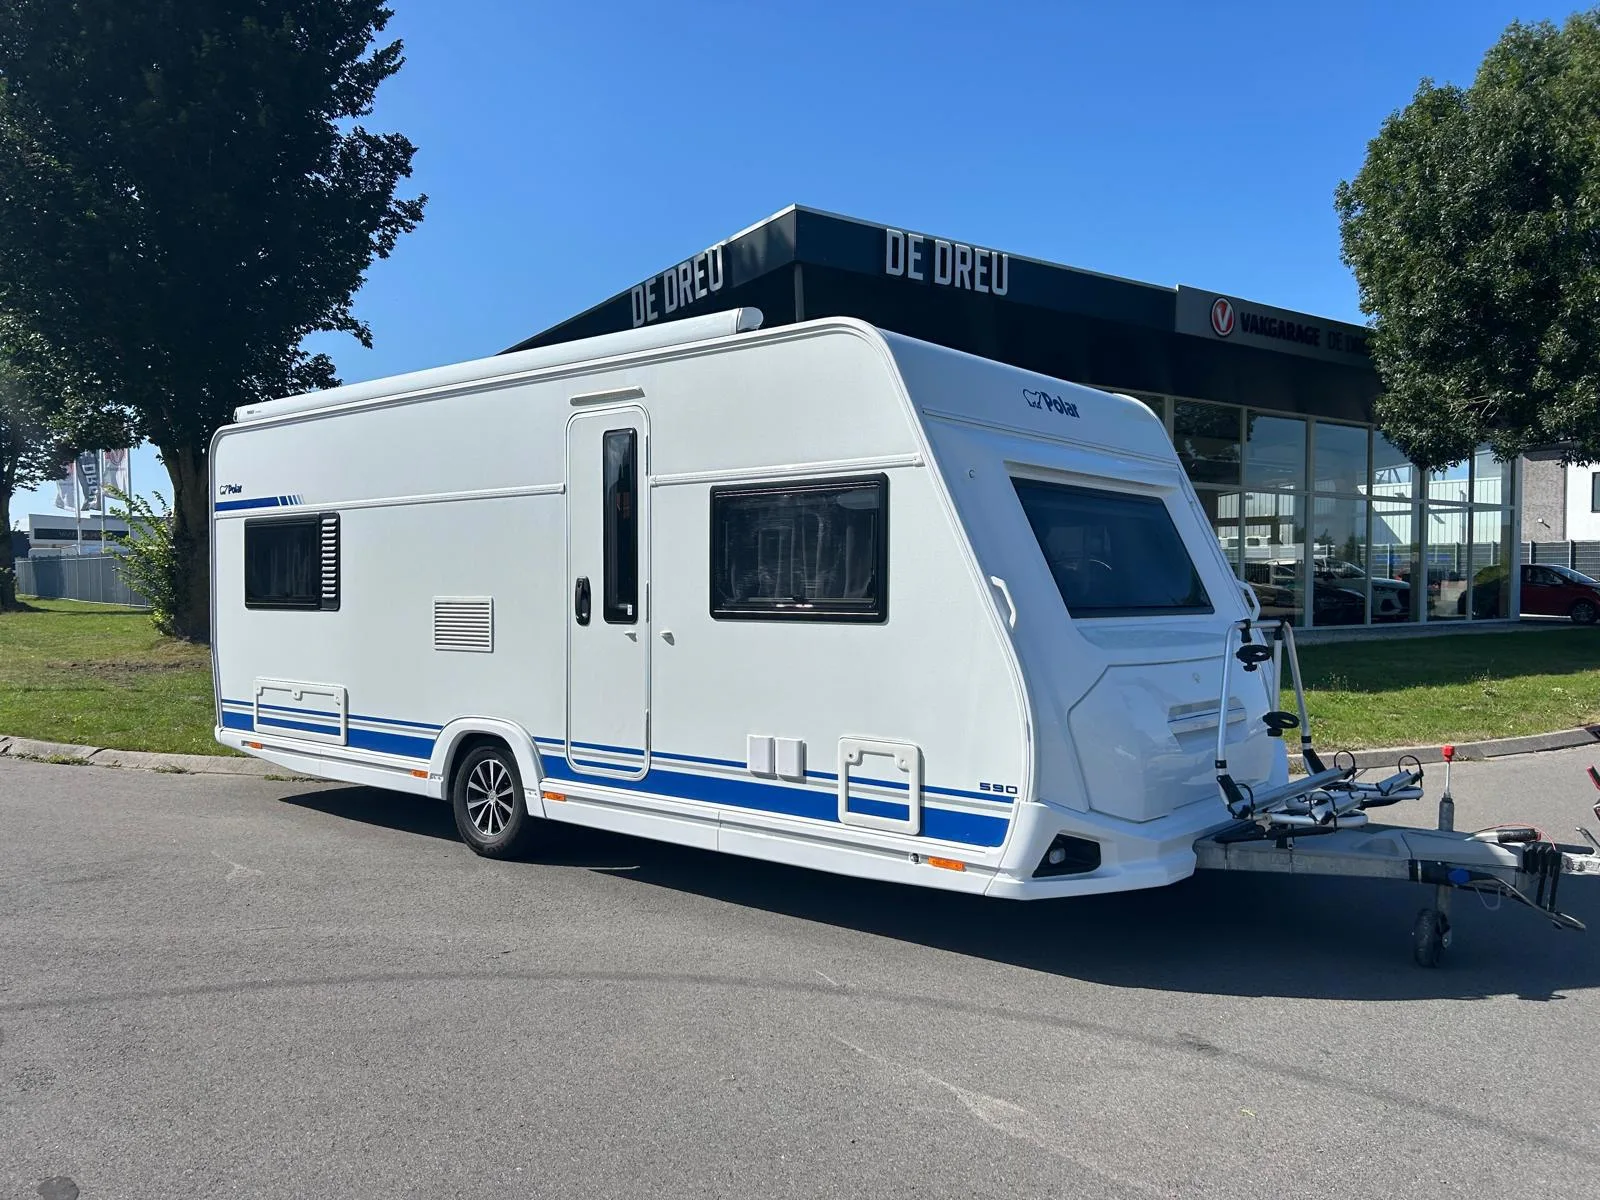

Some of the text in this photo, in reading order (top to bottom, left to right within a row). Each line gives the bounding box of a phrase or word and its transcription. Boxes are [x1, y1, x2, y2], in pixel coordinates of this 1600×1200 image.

[886, 228, 1009, 296] DE DREU
[631, 244, 724, 328] DE DREU
[1240, 312, 1320, 347] VAKGARAGE
[1328, 331, 1342, 351] DE
[1040, 391, 1080, 418] Polar
[228, 484, 242, 494] Polar
[979, 782, 1018, 794] 590
